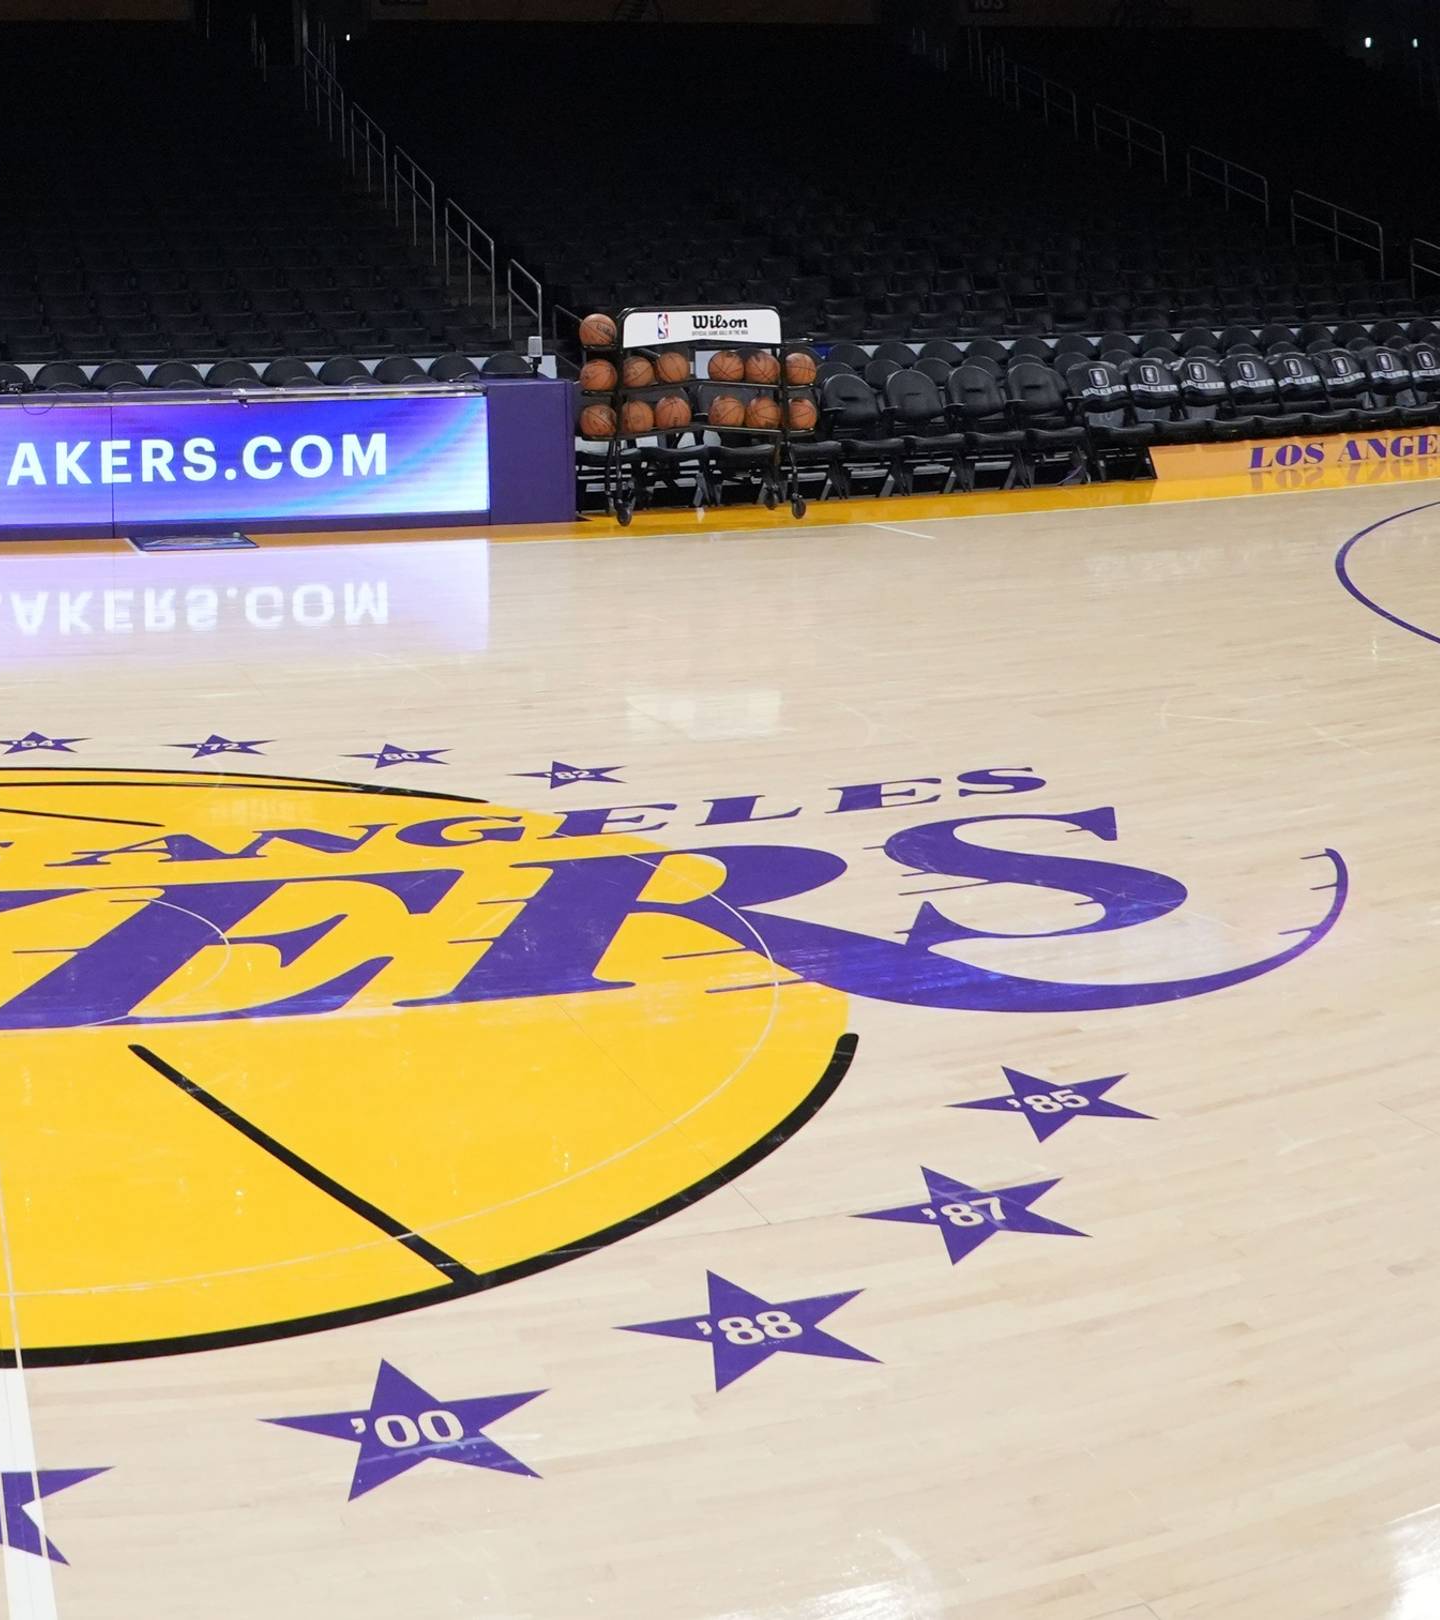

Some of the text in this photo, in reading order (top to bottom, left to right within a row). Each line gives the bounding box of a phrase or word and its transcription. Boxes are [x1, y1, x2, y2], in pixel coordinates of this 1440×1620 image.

[691, 314, 748, 329] Wilson
[1250, 434, 1440, 469] LOS ANGE
[195, 742, 242, 751] '72
[43, 766, 1047, 868] ANGELES
[1006, 1089, 1090, 1114] '85
[921, 1196, 1010, 1227] '87
[696, 1310, 803, 1346] '88
[351, 1410, 464, 1449] '00
